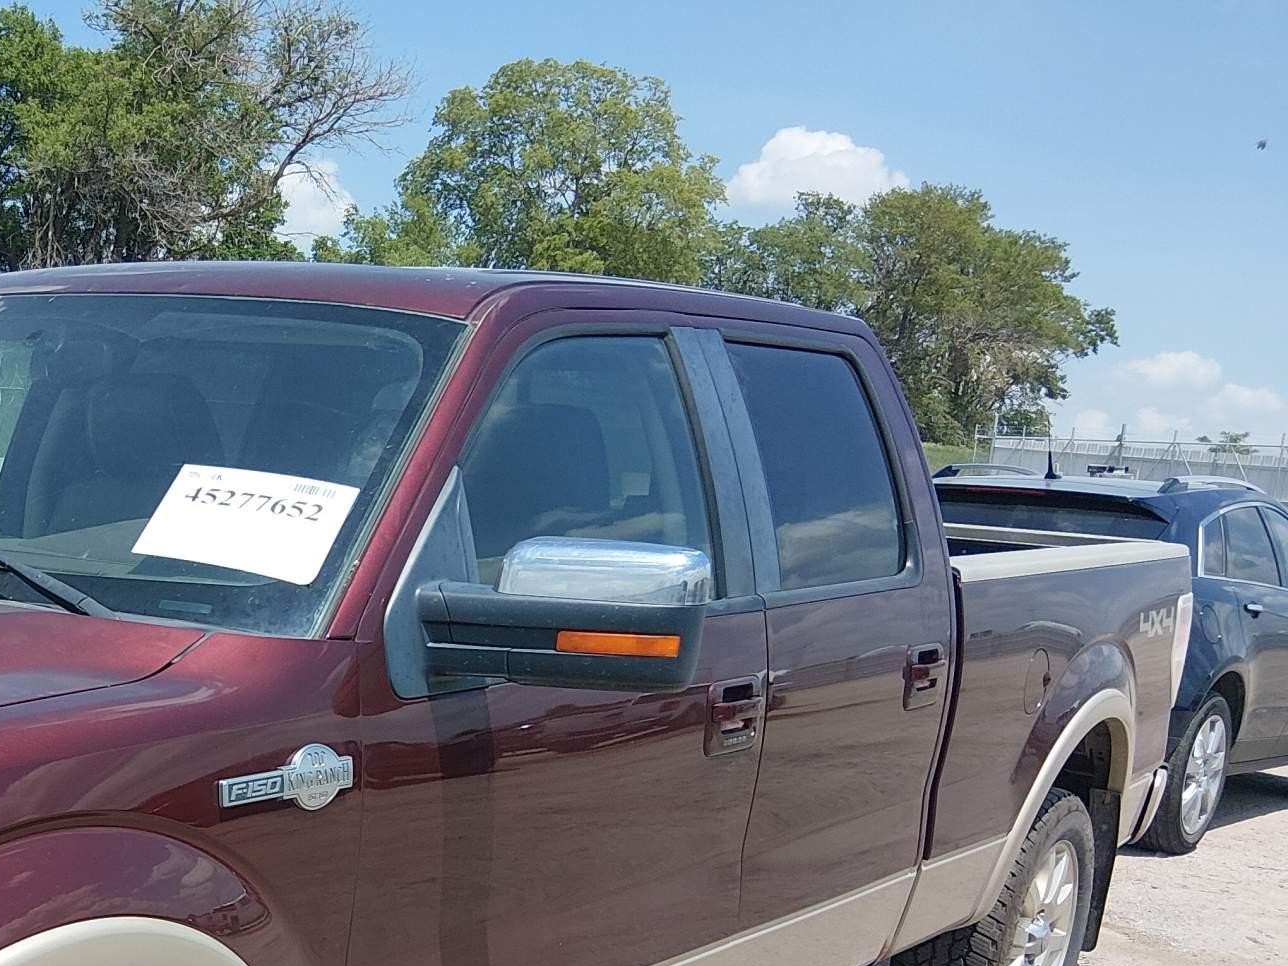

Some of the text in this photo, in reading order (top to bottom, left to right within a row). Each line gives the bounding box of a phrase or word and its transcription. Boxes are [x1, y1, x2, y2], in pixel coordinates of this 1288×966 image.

[184, 486, 324, 522] 45277652
[315, 762, 350, 787] RANCH
[229, 778, 282, 801] F-150
